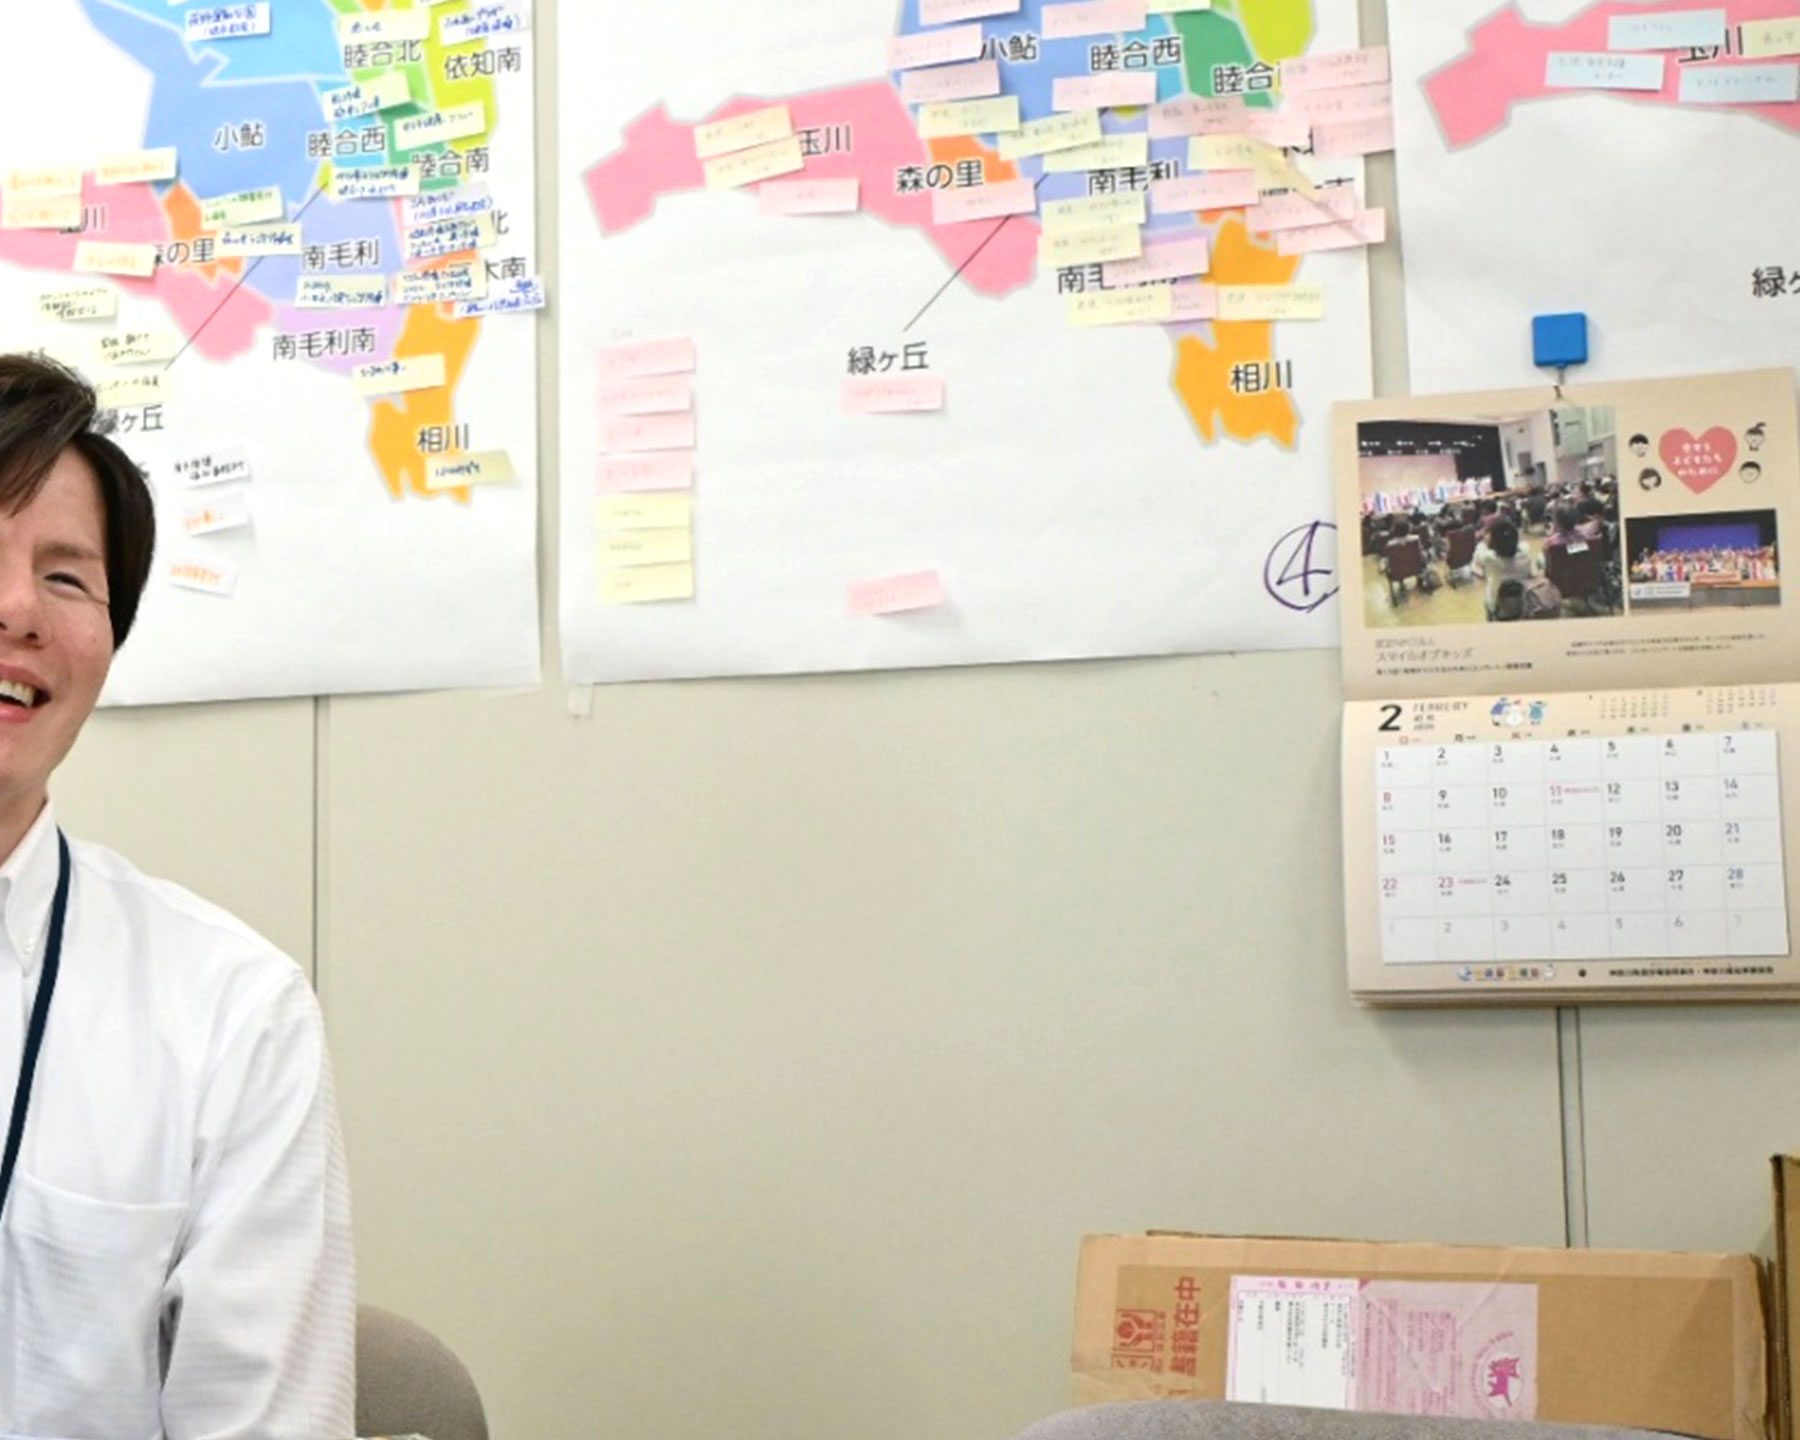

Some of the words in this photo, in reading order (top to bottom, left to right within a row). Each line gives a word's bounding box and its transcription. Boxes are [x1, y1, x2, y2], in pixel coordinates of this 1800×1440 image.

[444, 47, 521, 80] 依知南
[979, 35, 1037, 62] 小鮎
[1091, 36, 1181, 72] 睦合西
[1214, 64, 1281, 93] 睦合
[214, 122, 264, 150] 小鮎
[307, 127, 386, 157] 睦合西
[800, 126, 851, 156] 玉川
[896, 160, 983, 193] 森の里
[302, 240, 379, 270] 南毛利
[272, 328, 376, 361] 南毛利南
[848, 341, 929, 375] 緑ヶ丘
[1231, 360, 1292, 392] 相川
[418, 424, 470, 453] 相川
[1378, 704, 1402, 732] 2
[1492, 787, 1507, 799] 10
[1607, 783, 1621, 795] 12
[1665, 780, 1679, 792] 13
[1724, 778, 1738, 790] 14
[1383, 834, 1396, 845] 15
[1438, 832, 1452, 844] 16
[1495, 830, 1508, 842] 17
[1551, 828, 1565, 840] 18
[1609, 826, 1623, 838] 19
[1666, 824, 1682, 837] 20
[1725, 822, 1740, 835] 21
[1383, 878, 1397, 890] 22
[1438, 876, 1453, 889] 23
[1495, 874, 1511, 887] 24
[1552, 872, 1567, 885] 25
[1610, 871, 1625, 884] 26
[1668, 869, 1684, 882] 27
[1727, 868, 1744, 881] 28
